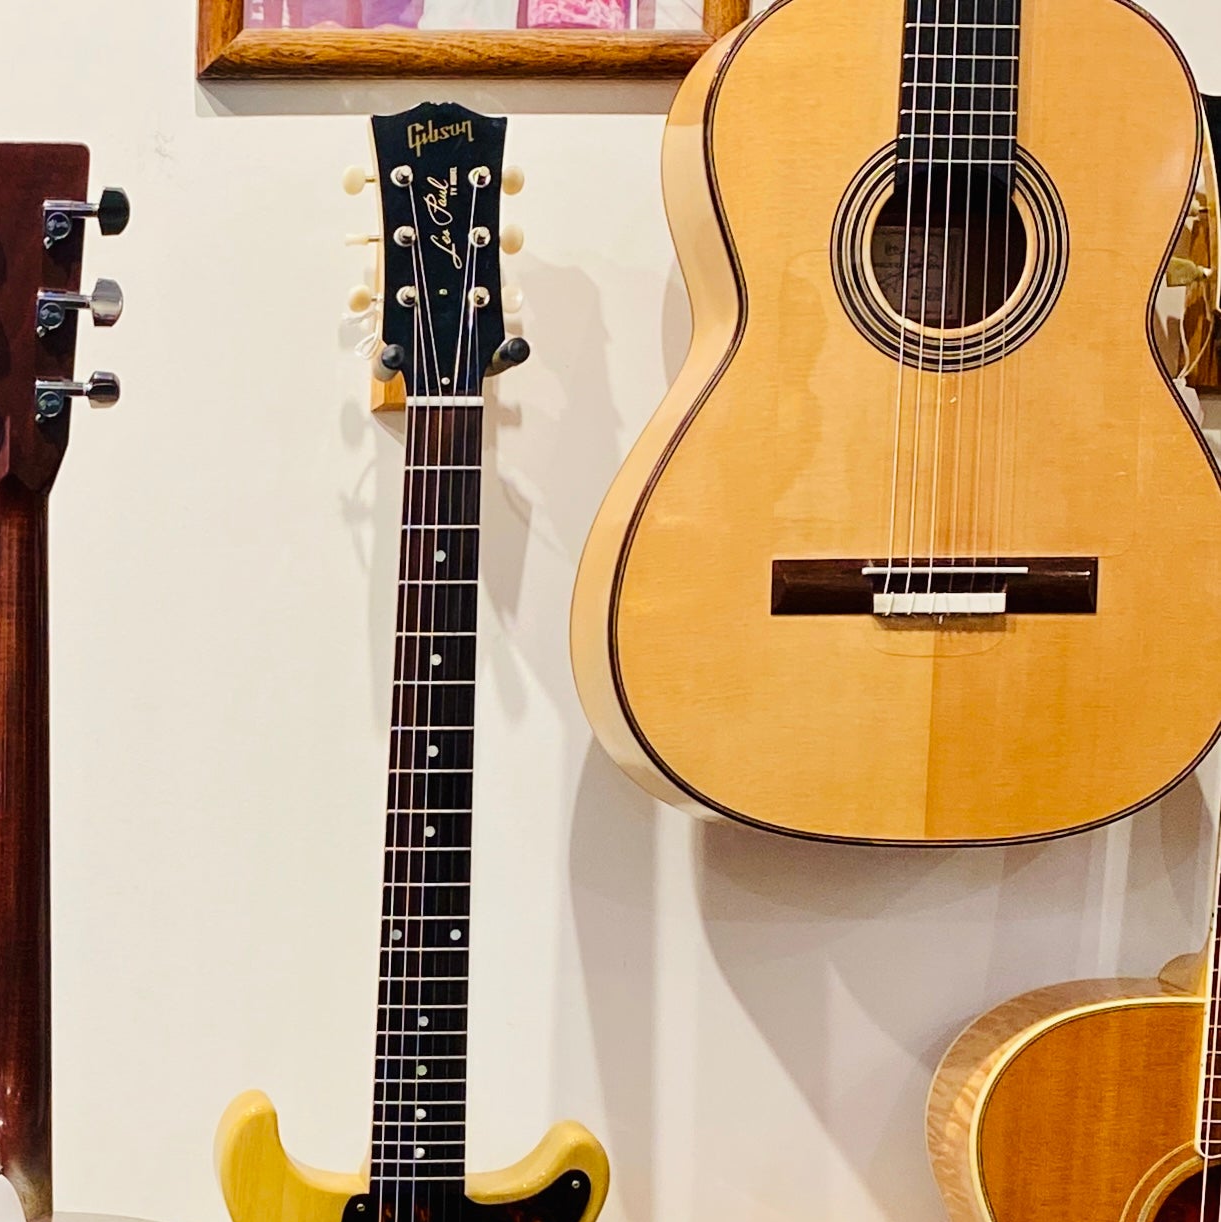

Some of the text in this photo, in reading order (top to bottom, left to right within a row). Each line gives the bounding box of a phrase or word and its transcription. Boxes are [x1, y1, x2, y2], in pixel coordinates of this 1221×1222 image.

[407, 119, 475, 158] Gibson
[423, 176, 463, 270] Les Paul
